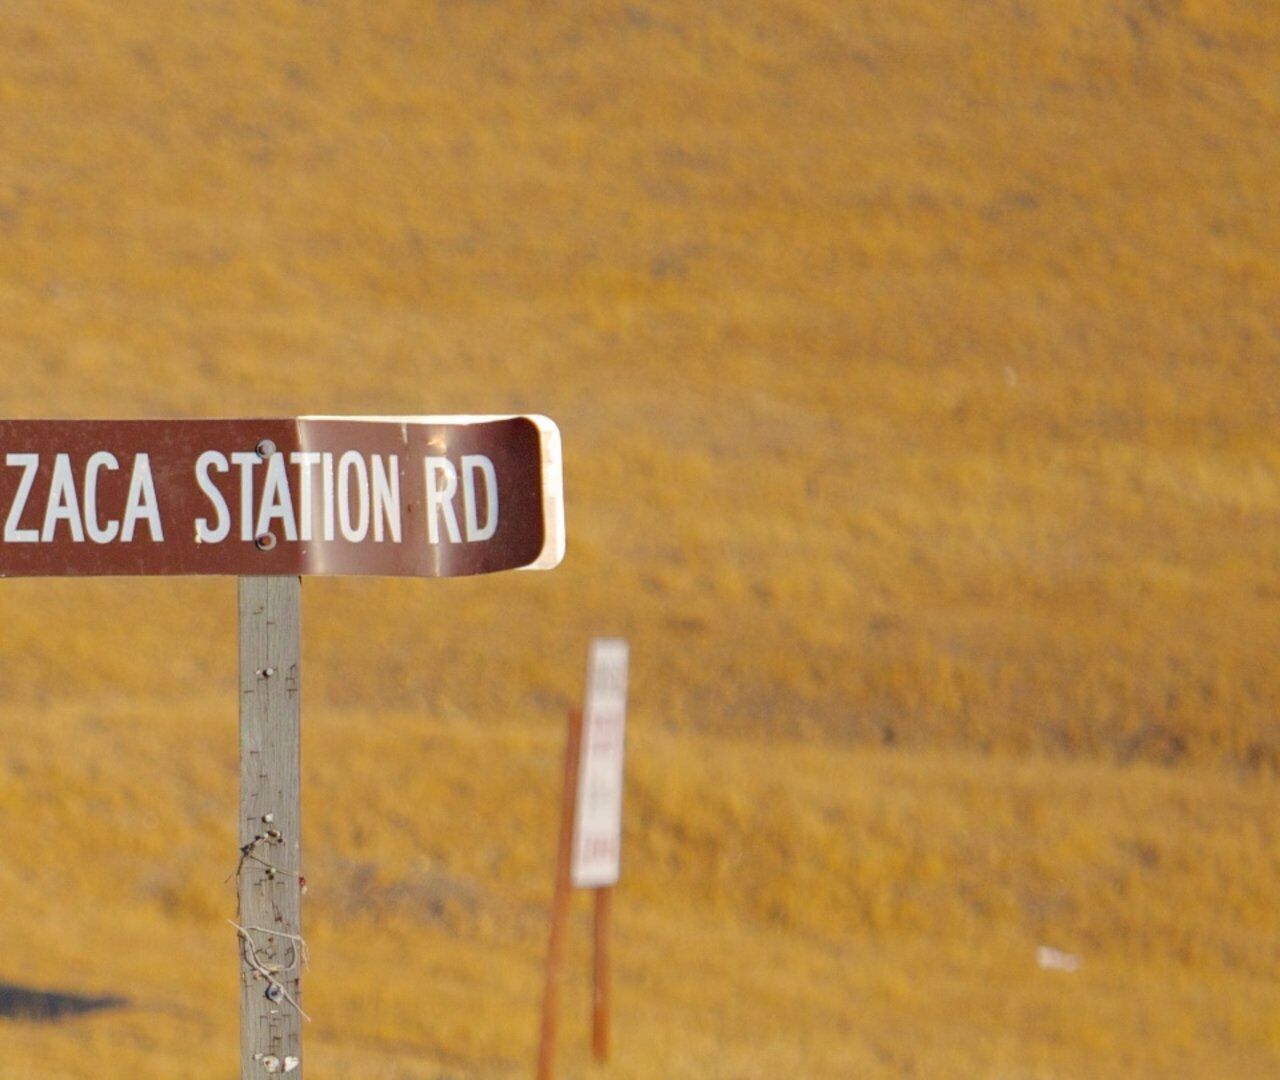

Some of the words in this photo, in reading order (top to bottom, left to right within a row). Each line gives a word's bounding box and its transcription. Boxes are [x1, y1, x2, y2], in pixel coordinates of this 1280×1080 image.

[4, 451, 164, 543] ZACA
[194, 450, 403, 544] STATION
[424, 454, 498, 544] RD
